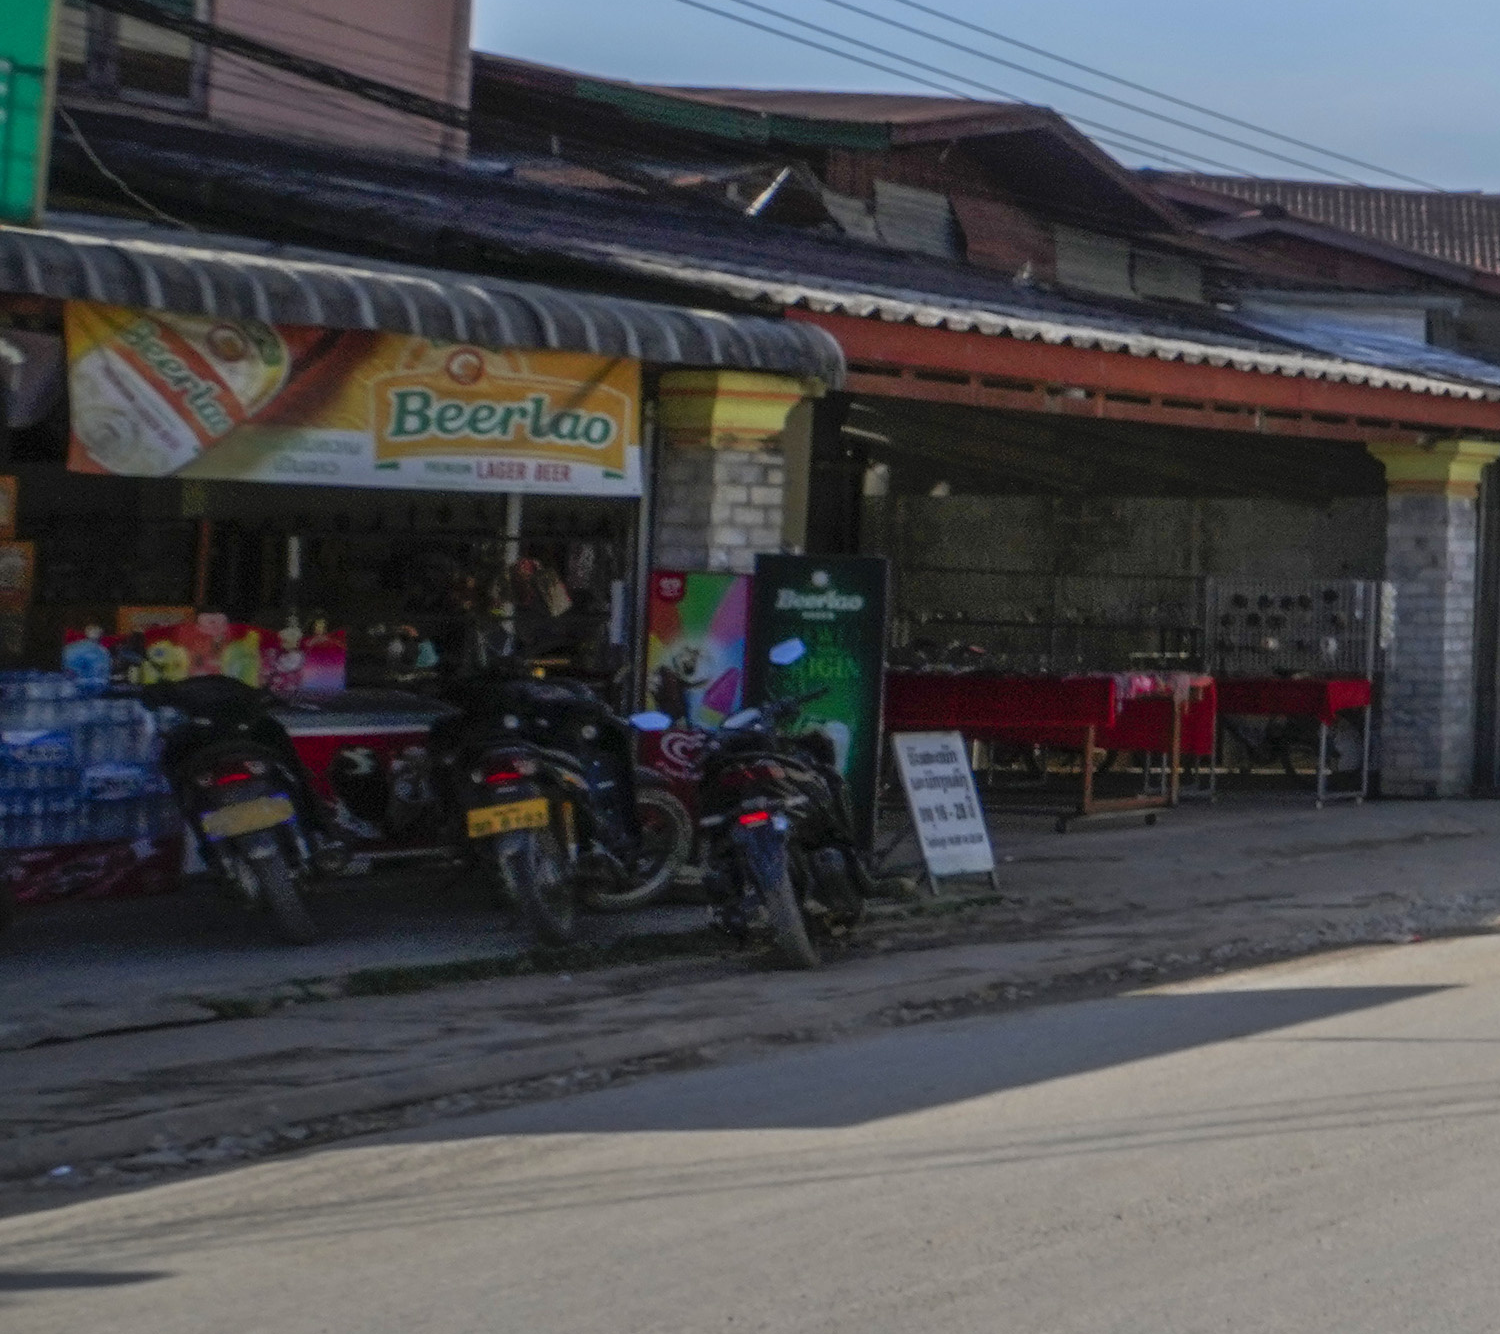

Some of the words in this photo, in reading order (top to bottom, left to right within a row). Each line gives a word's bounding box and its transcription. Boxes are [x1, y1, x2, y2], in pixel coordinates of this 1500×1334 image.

[391, 389, 612, 445] Beerlao
[476, 460, 527, 481] LAGER
[534, 463, 573, 483] BEER
